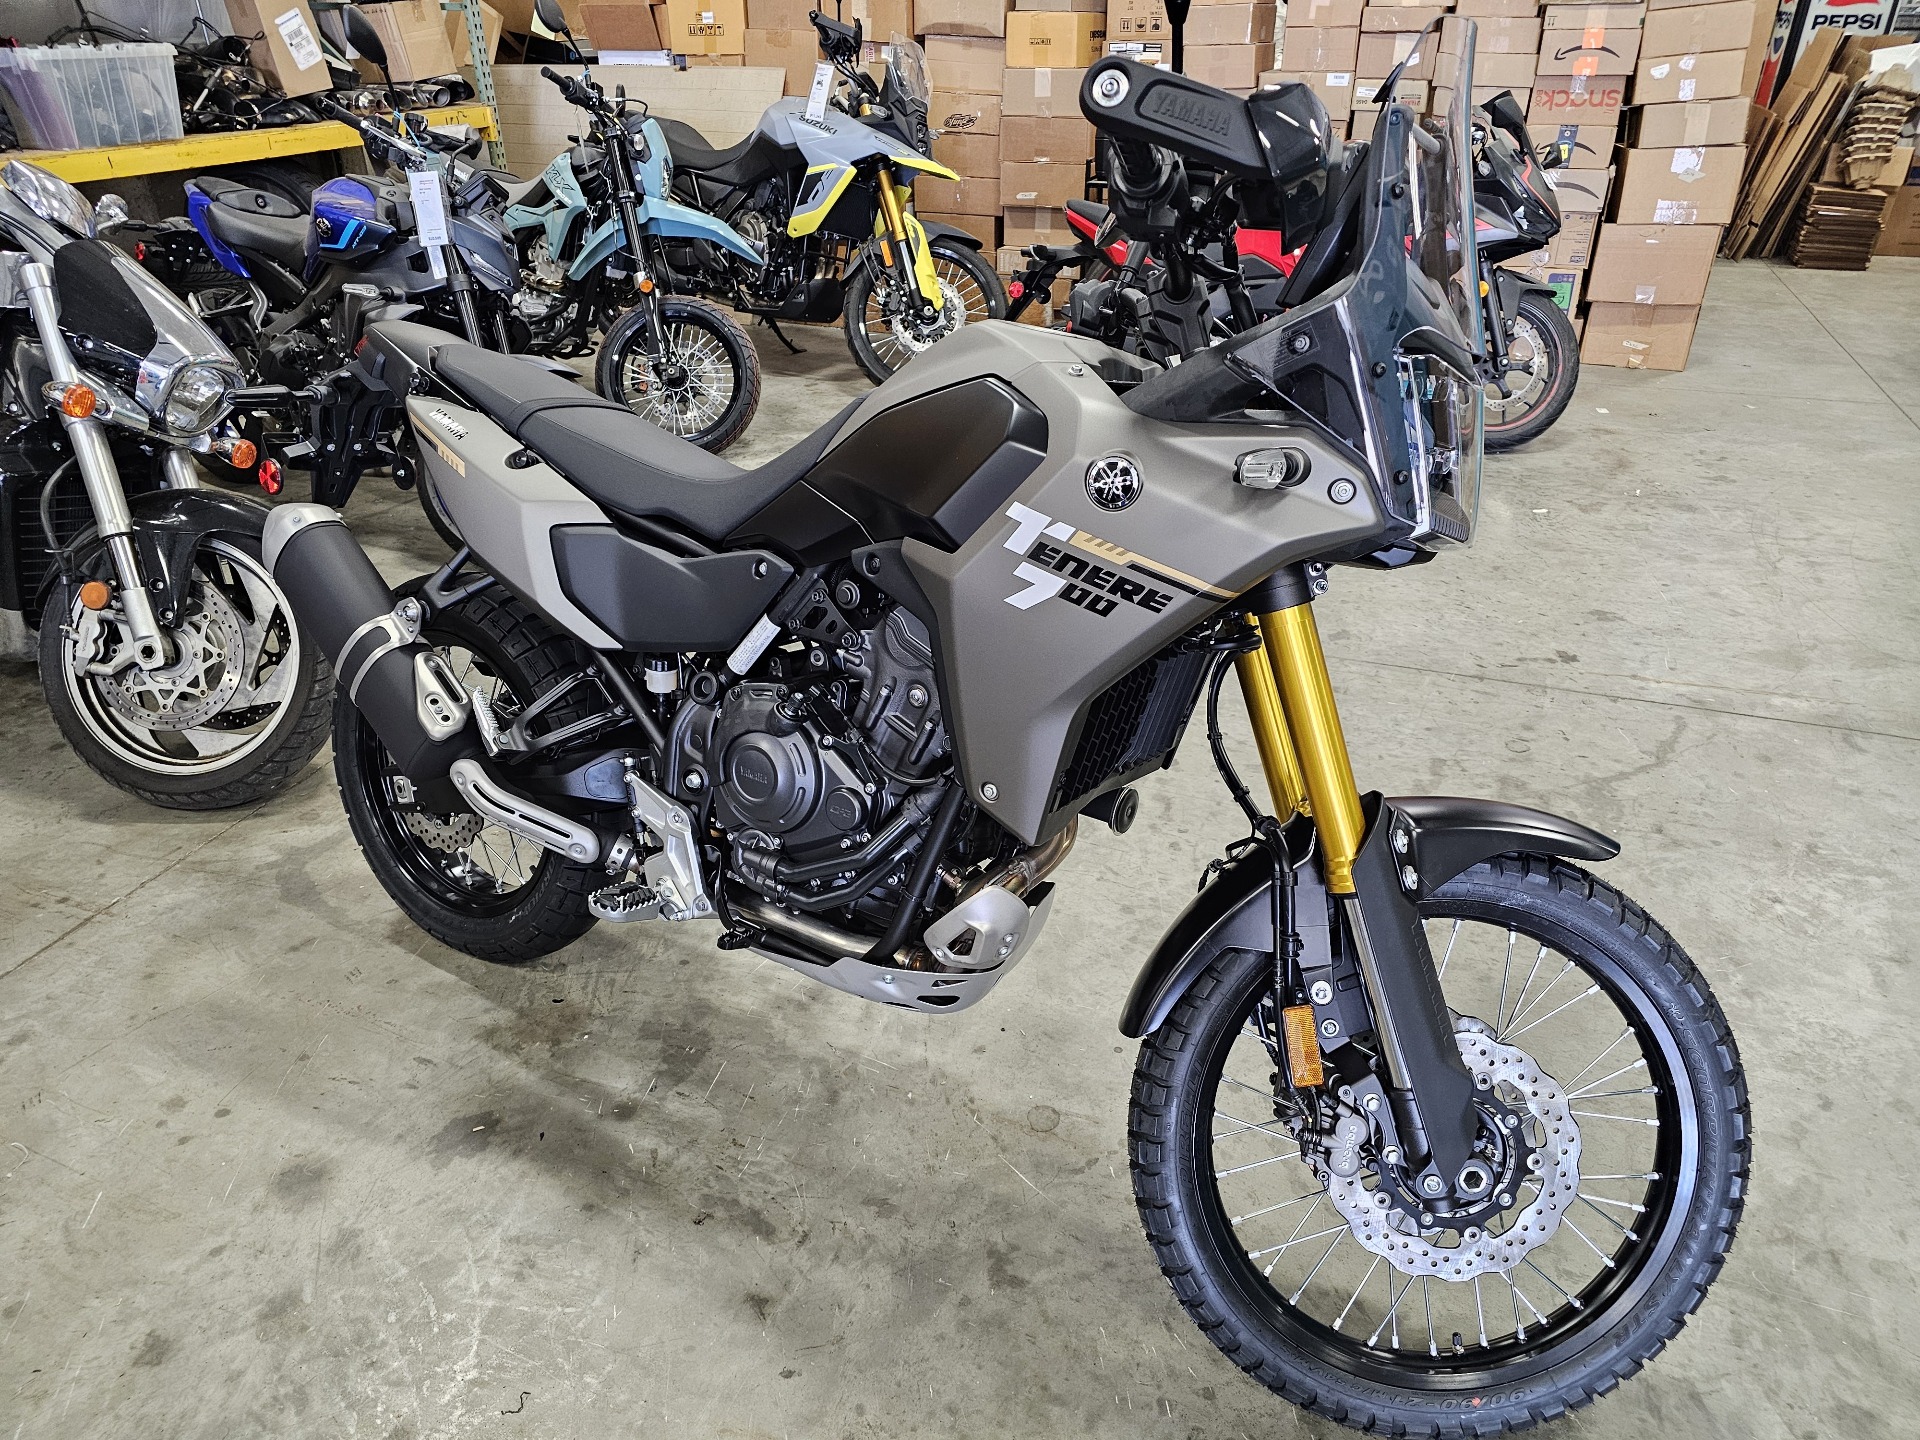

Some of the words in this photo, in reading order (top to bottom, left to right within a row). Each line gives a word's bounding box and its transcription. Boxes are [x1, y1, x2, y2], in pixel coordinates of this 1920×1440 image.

[1811, 13, 1884, 30] PEPSI
[1152, 90, 1232, 137] YAMAHA
[1541, 88, 1622, 112] snack
[798, 114, 838, 136] SUZUKI
[545, 163, 577, 193] KLX
[1003, 561, 1120, 618] 700
[1178, 1058, 1203, 1190] PIRELLI
[1675, 1026, 1720, 1197] SCORPION
[1337, 1125, 1359, 1170] brembo
[1663, 1201, 1711, 1297] RALLY
[1613, 1299, 1662, 1347] STR
